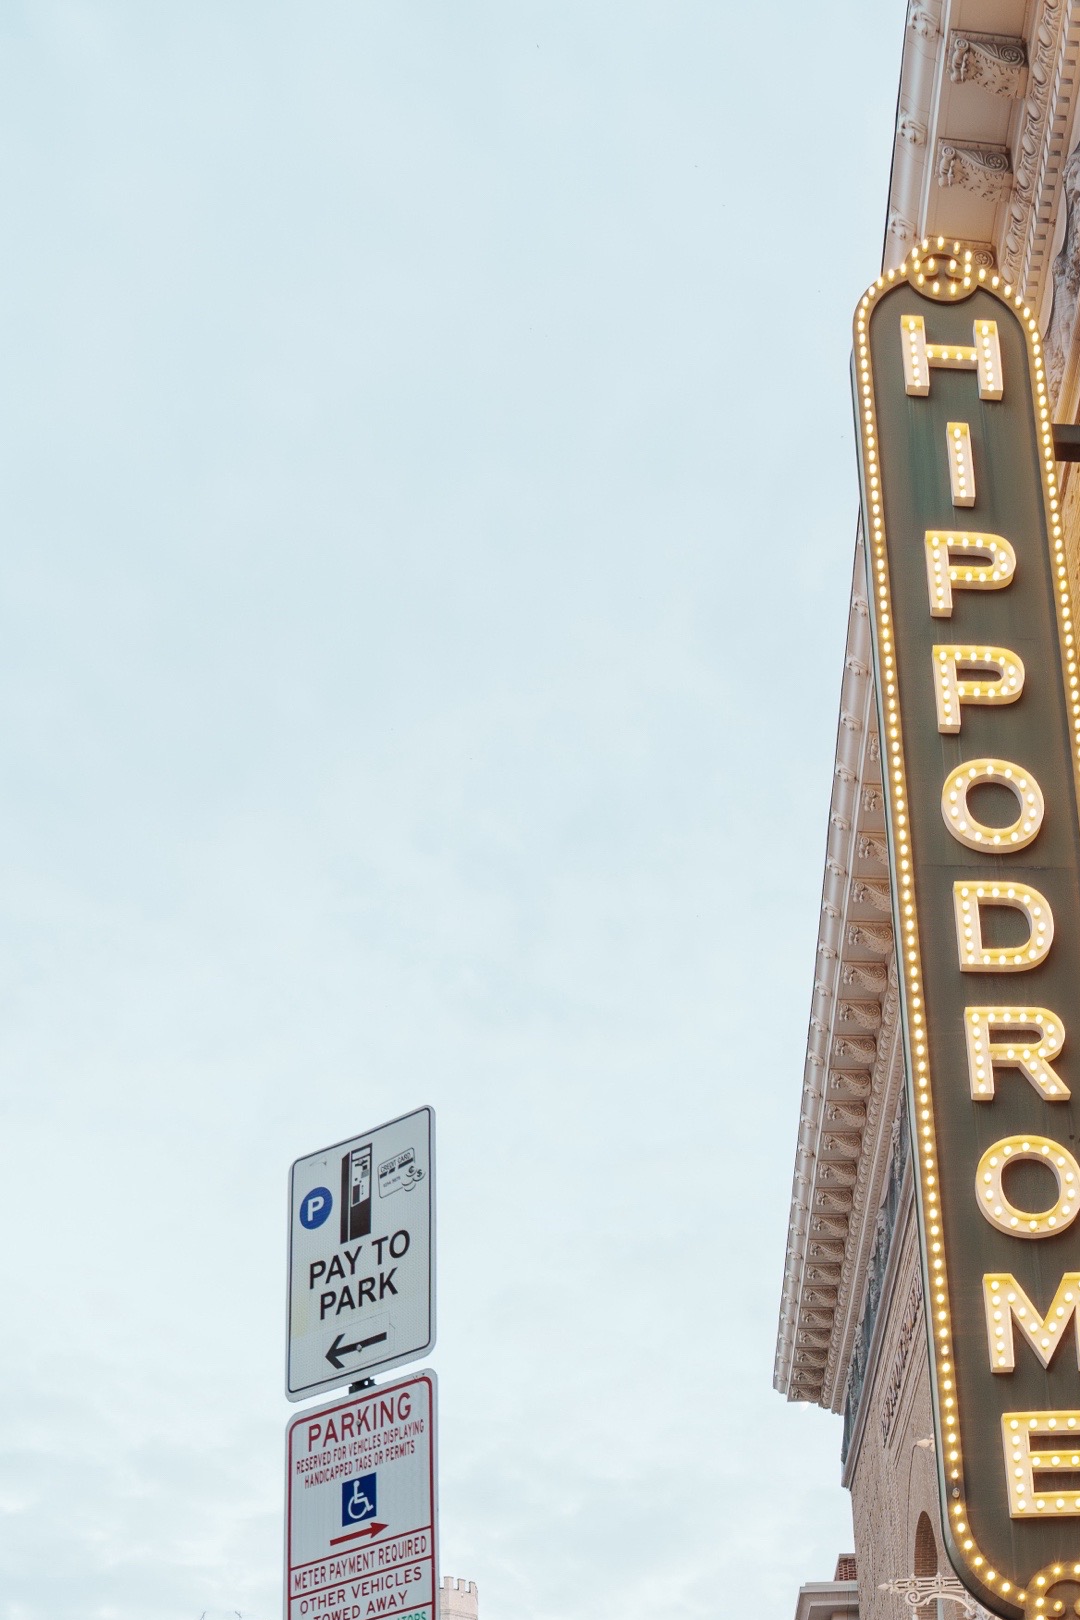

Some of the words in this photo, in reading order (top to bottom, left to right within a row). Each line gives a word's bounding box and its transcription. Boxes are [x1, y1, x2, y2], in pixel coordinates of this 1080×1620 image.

[309, 1246, 363, 1290] PAY
[371, 1229, 411, 1266] TO
[320, 1267, 398, 1321] PARK
[296, 1451, 332, 1475] RESERVED
[333, 1445, 347, 1461] FOR
[348, 1431, 382, 1458] VEHICLES
[383, 1418, 425, 1446] DISPLAYING
[308, 1392, 412, 1452] PARKING
[304, 1463, 353, 1489] HANDICAPPED
[355, 1457, 372, 1474] TAGS
[374, 1453, 384, 1467] OR
[385, 1439, 415, 1463] PERMITS
[294, 1567, 328, 1591] METER
[329, 1550, 375, 1584] PAYMENT
[378, 1535, 427, 1566] REQUIRED
[300, 1586, 346, 1615] OTHER
[351, 1565, 422, 1600] VEHICLES
[366, 1590, 408, 1616] AWAY
